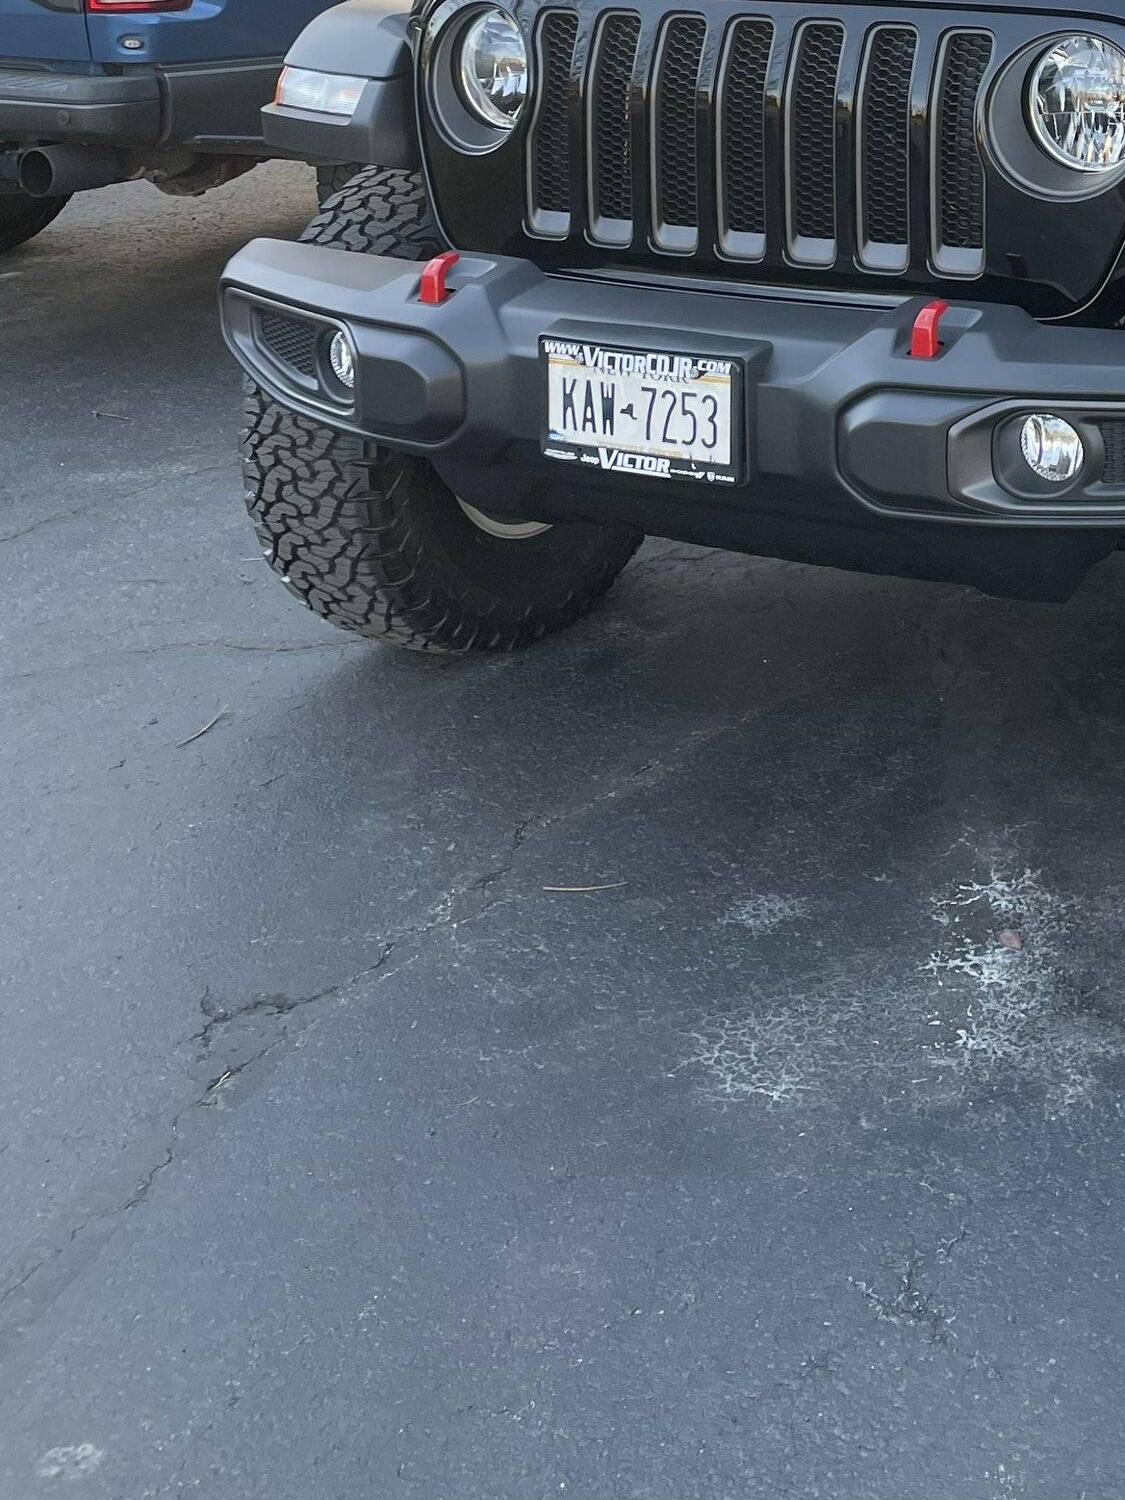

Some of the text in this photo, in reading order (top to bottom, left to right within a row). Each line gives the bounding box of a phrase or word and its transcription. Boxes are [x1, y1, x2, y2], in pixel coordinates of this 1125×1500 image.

[562, 376, 718, 449] KAW 7253
[598, 447, 671, 473] VICTOR
